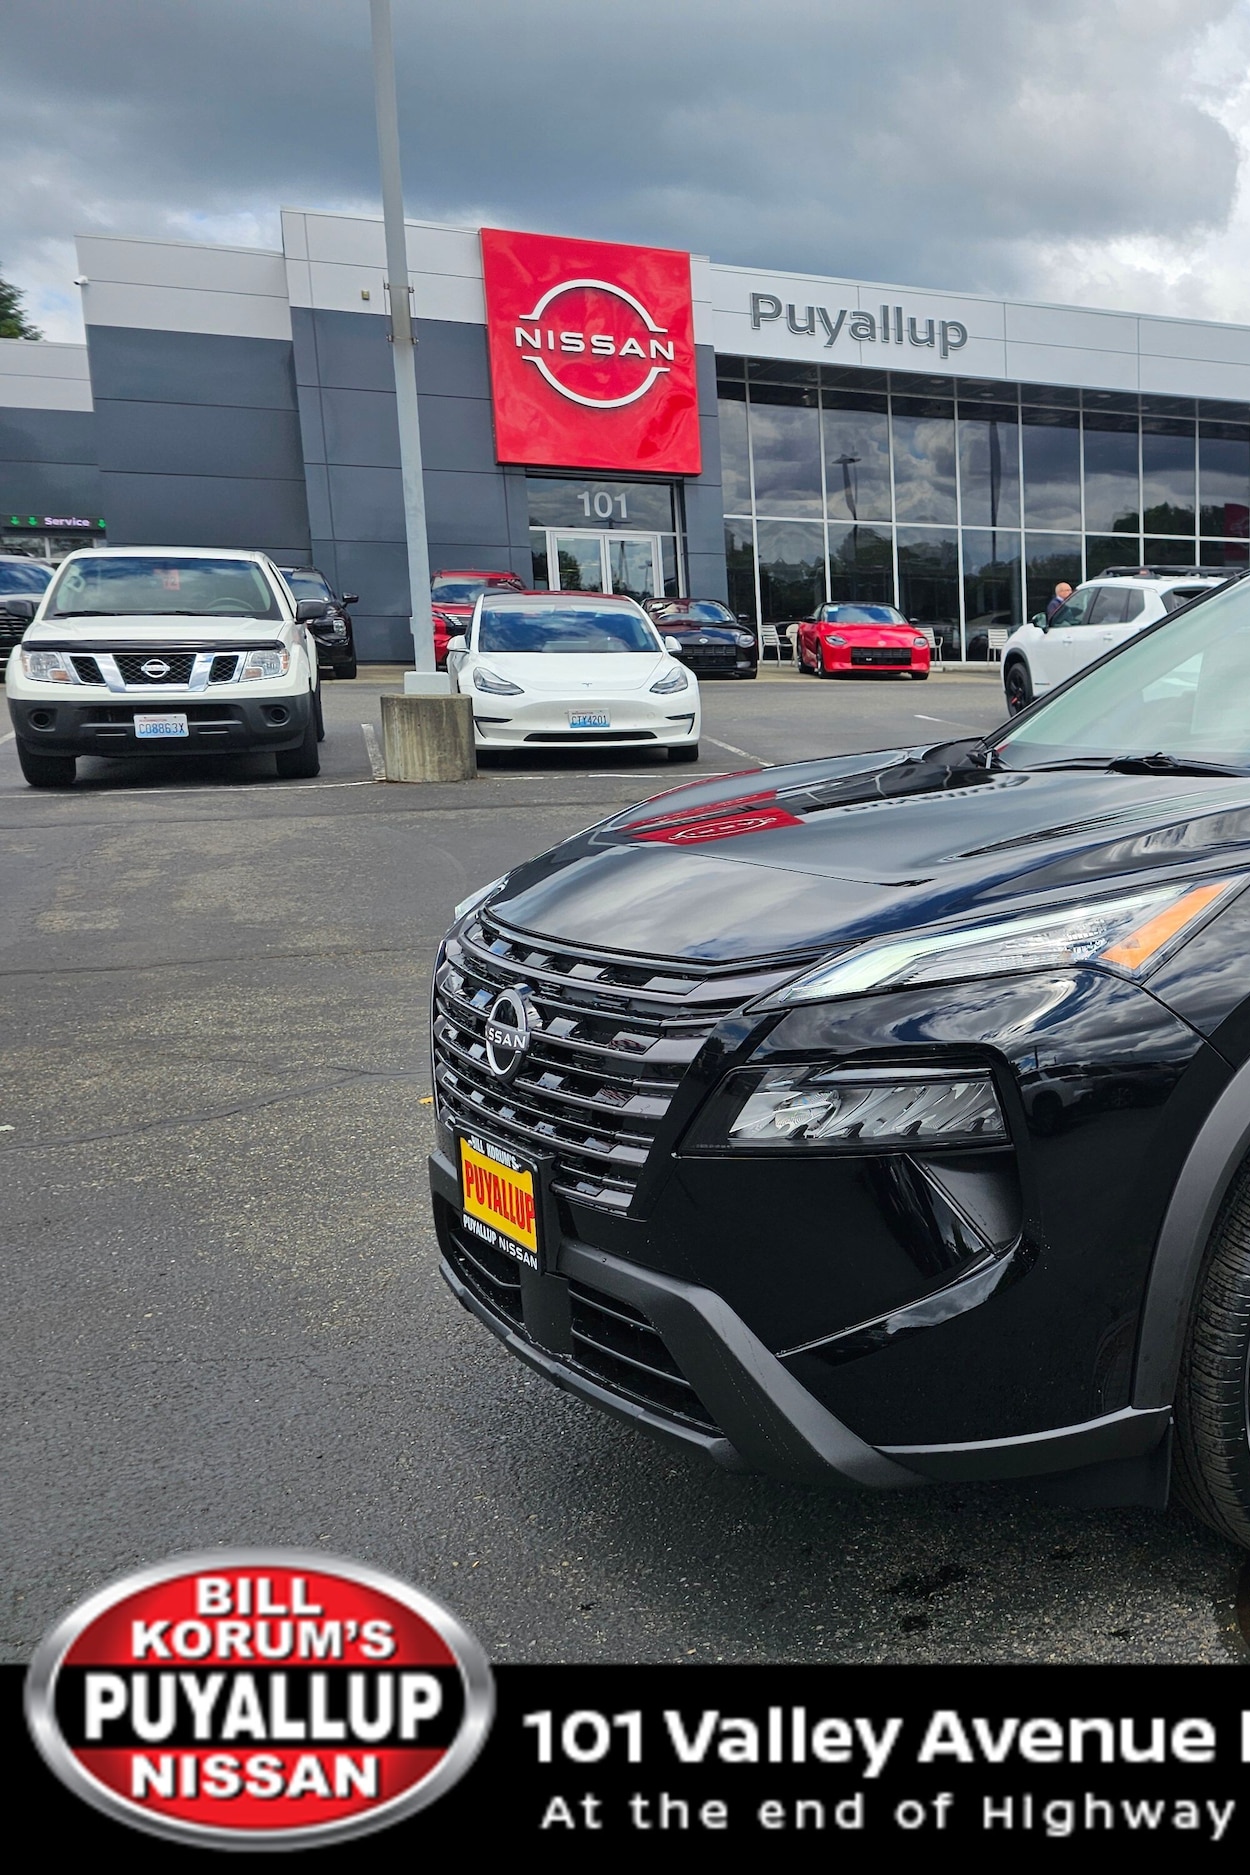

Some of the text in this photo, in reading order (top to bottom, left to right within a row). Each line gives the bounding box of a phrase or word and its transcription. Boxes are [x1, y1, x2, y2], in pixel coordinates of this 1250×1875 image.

[750, 292, 968, 358] Puyallup
[515, 327, 674, 360] NISSAN
[577, 491, 627, 518] 101
[44, 516, 91, 527] Service
[488, 1027, 527, 1049] SSAN
[464, 1159, 536, 1234] PUYALLUP
[463, 1214, 538, 1270] PUYALLUP NISSAN
